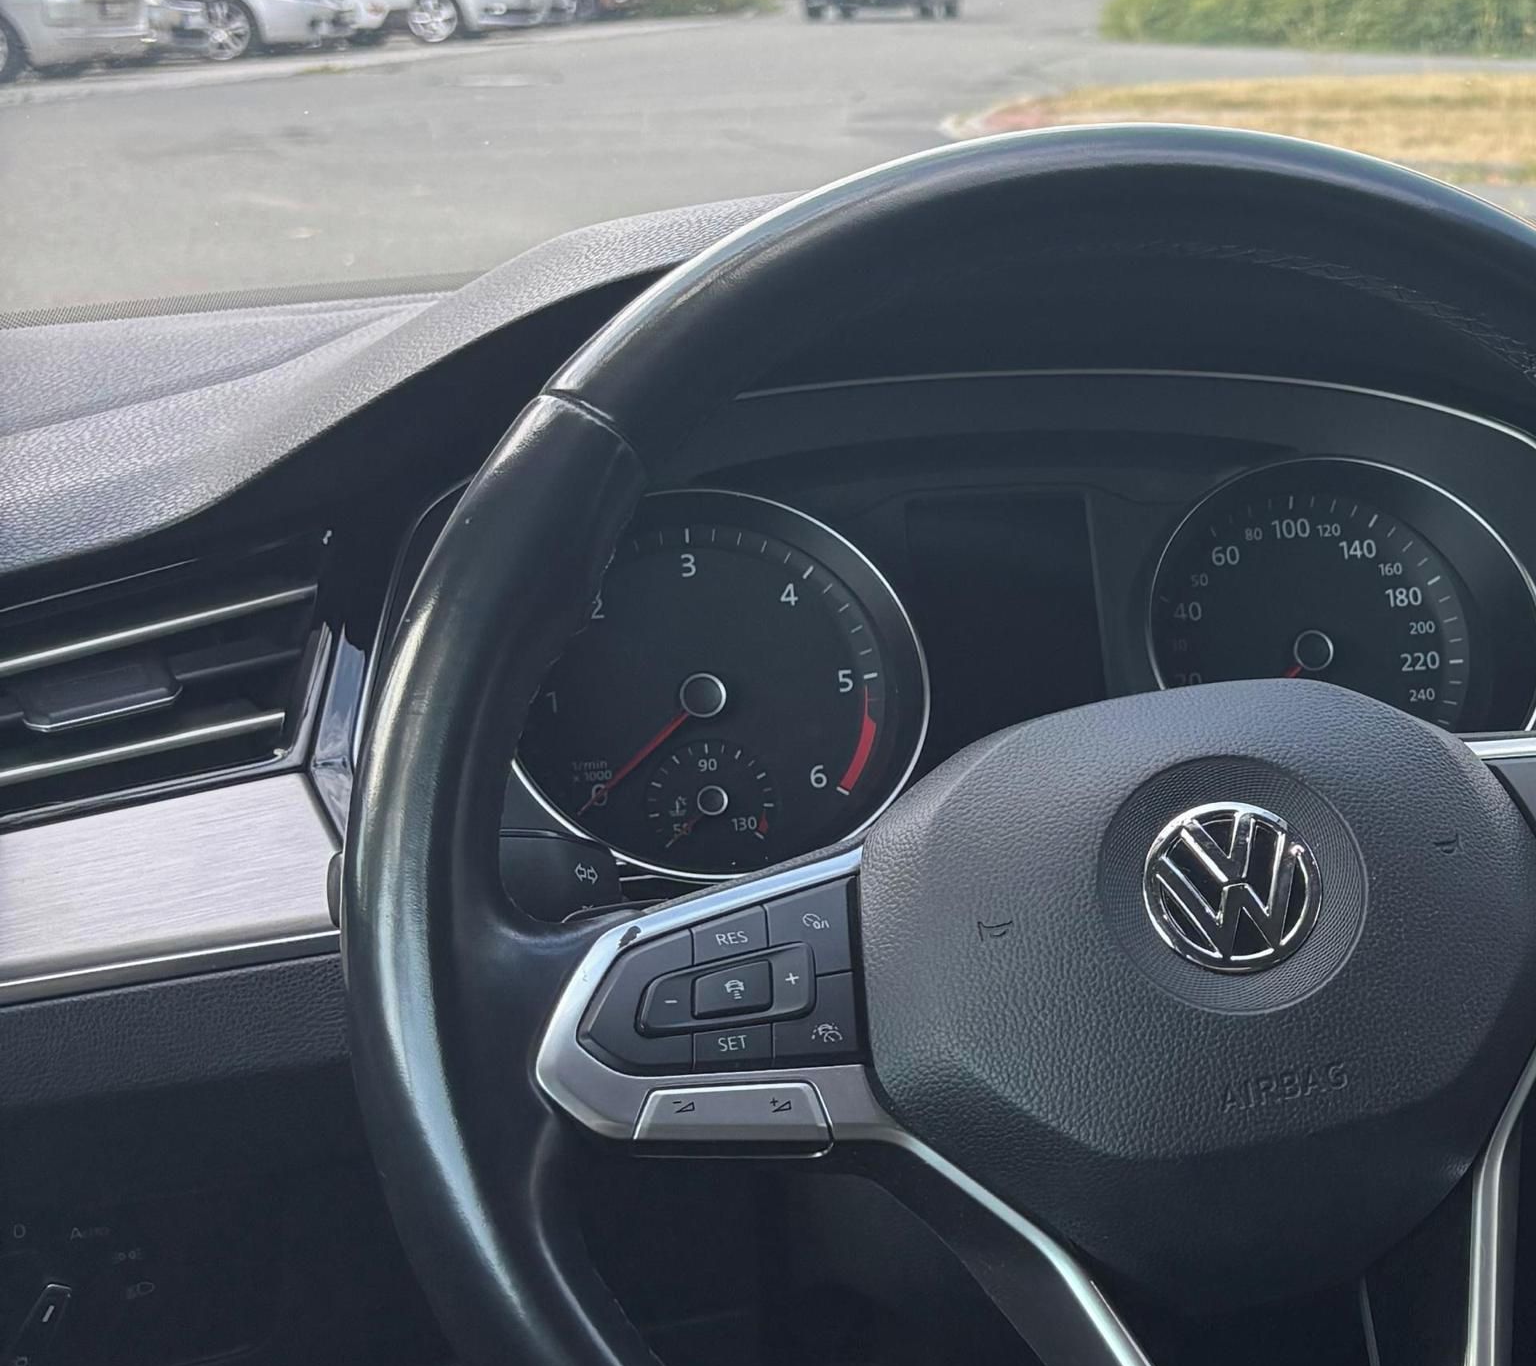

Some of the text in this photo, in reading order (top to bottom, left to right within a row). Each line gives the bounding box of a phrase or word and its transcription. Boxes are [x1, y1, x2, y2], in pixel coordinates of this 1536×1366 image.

[1245, 526, 1263, 542] 80
[1271, 517, 1311, 540] 100
[1316, 522, 1342, 538] 120
[1211, 544, 1240, 567] 60
[1339, 539, 1377, 561] 140
[681, 553, 697, 578] 3
[1378, 561, 1403, 577] 160
[1190, 572, 1209, 588] 50
[780, 582, 799, 607] 4
[1385, 587, 1423, 608] 180
[591, 596, 606, 620] 2
[1173, 601, 1203, 622] 40
[1409, 619, 1436, 635] 200
[1400, 650, 1440, 673] 220
[838, 669, 854, 693] 5
[546, 690, 558, 714] 1
[1409, 686, 1436, 703] 240
[698, 758, 718, 772] 90
[810, 764, 828, 789] 6
[731, 815, 758, 832] 130
[714, 930, 749, 946] RES
[717, 1035, 748, 1051] SET
[1223, 1062, 1350, 1113] AIRBAG
